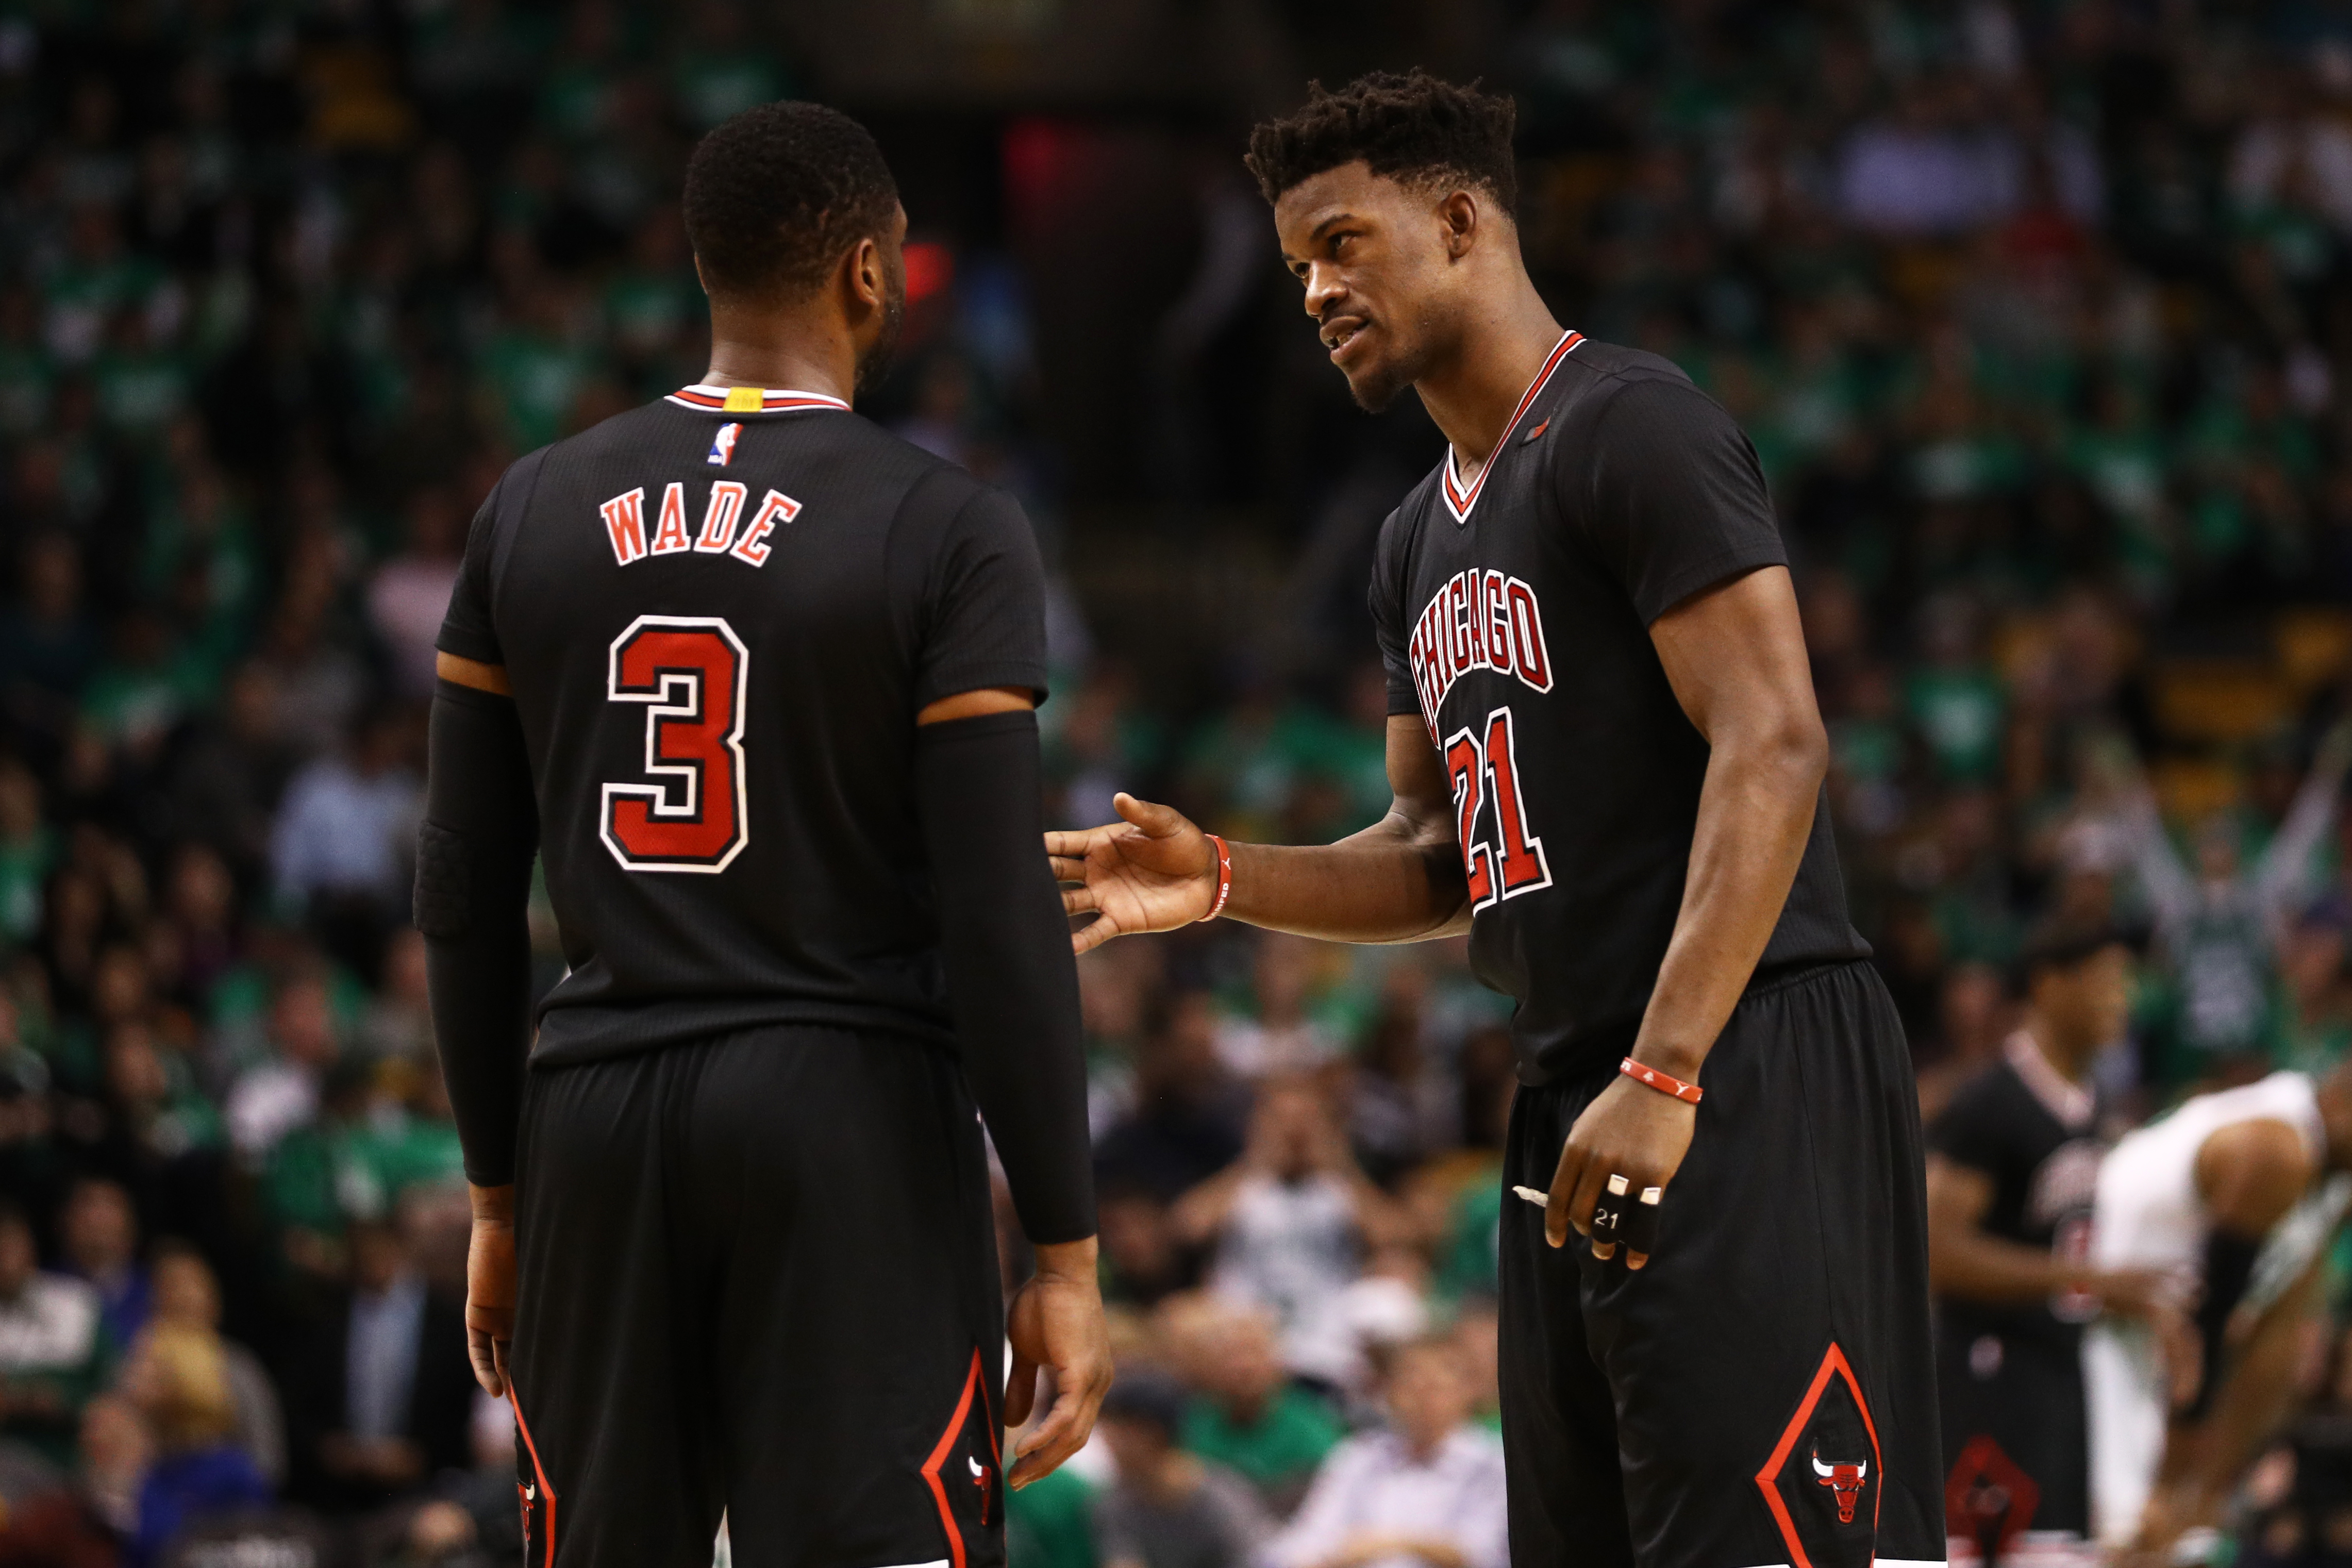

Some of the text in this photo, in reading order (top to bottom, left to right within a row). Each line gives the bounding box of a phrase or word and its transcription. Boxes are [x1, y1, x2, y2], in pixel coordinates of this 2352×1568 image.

[600, 480, 802, 568] WADE
[600, 614, 748, 873] 3
[1409, 568, 1554, 750] CHICAGO
[1445, 706, 1553, 918] 21
[1595, 1208, 1618, 1229] 21
